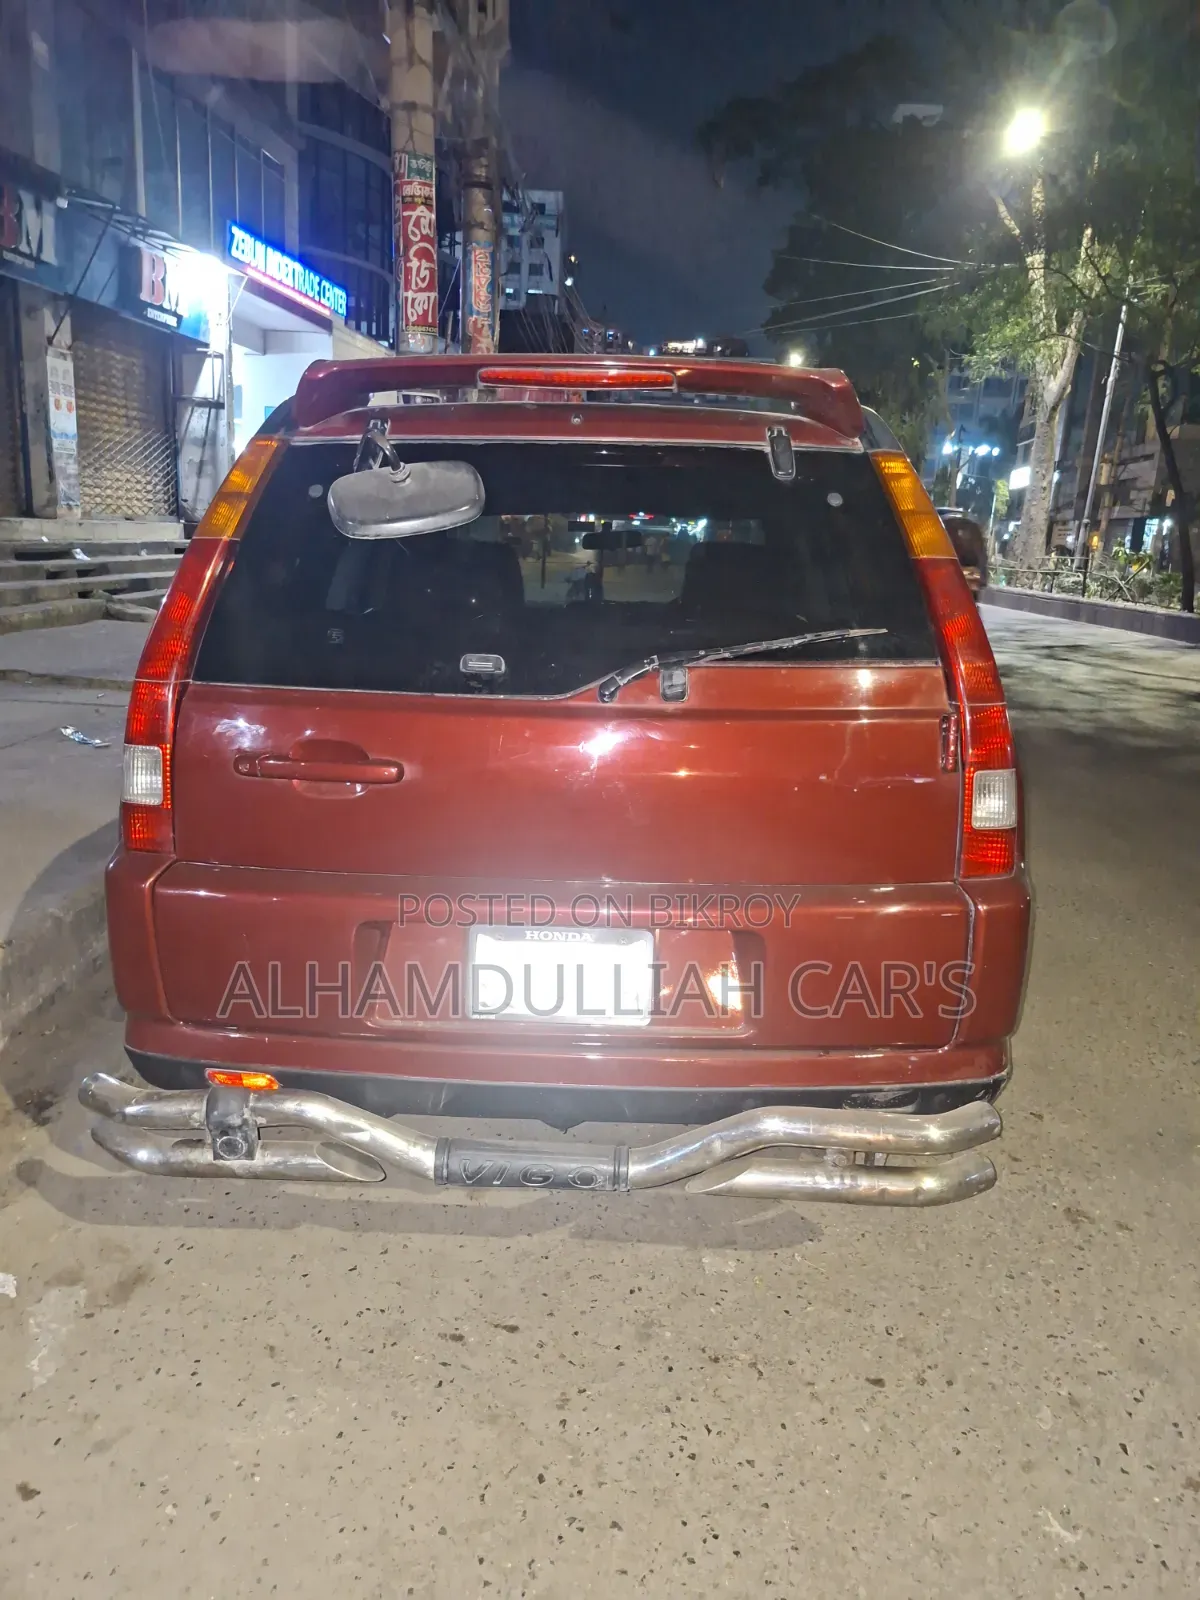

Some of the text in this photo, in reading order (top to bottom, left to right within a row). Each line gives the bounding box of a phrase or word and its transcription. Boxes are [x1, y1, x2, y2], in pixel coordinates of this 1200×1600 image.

[231, 225, 266, 274] ZEBUN
[320, 279, 347, 317] CENTER
[525, 930, 595, 943] HONDA
[459, 1158, 603, 1189] VIGO
